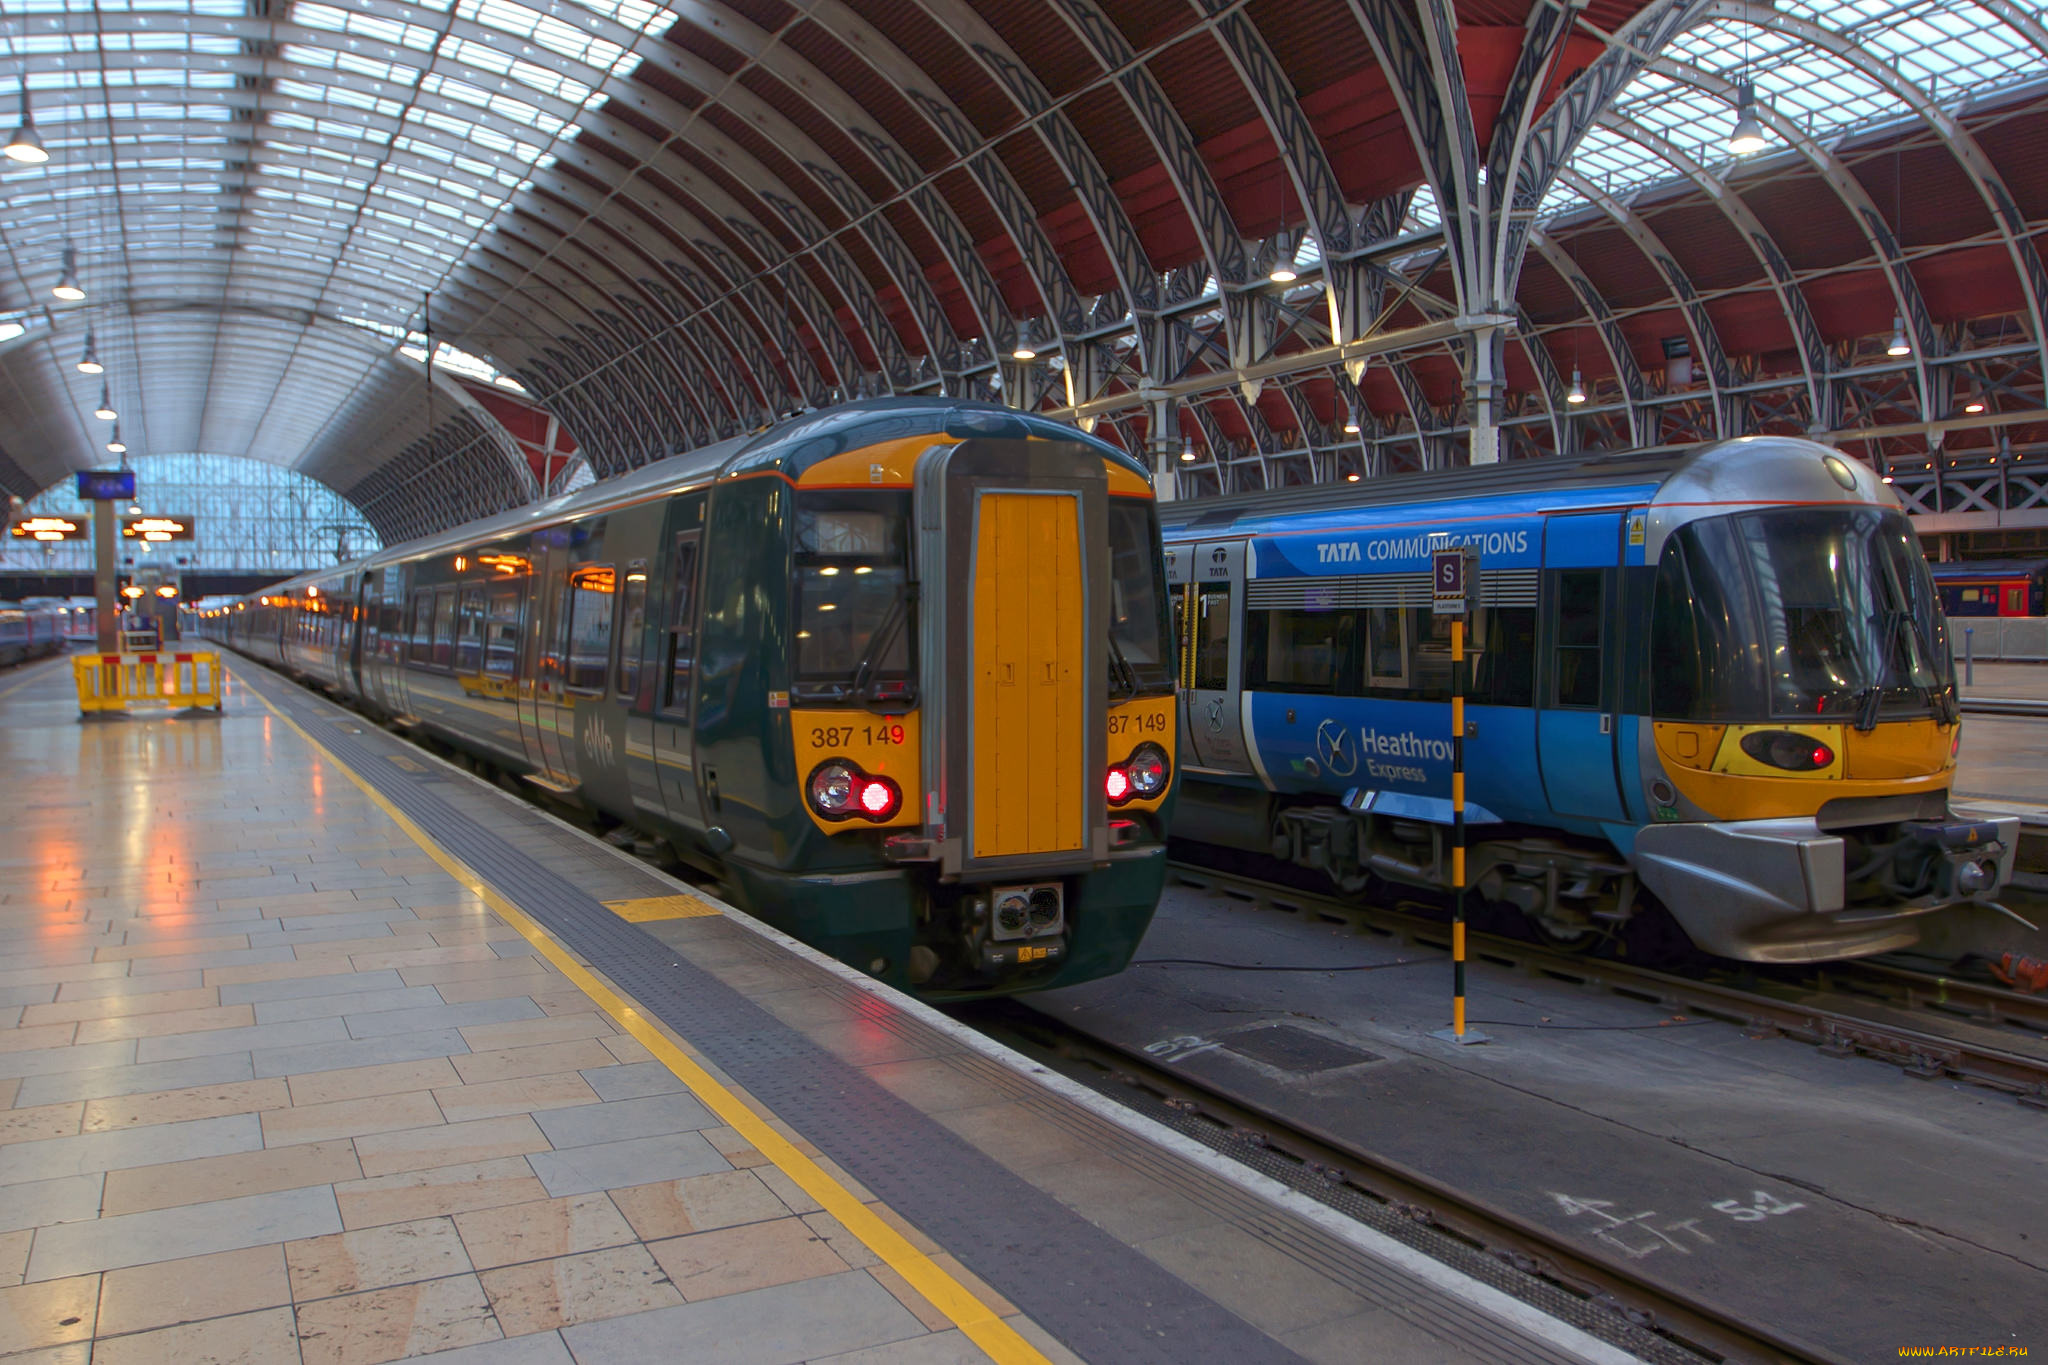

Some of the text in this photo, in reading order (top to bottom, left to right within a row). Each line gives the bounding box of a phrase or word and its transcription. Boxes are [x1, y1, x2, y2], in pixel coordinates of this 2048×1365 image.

[1317, 531, 1528, 562] TATA COMMUNICATIONS
[1210, 567, 1228, 577] TATA
[1443, 563, 1454, 584] S
[1108, 713, 1166, 734] 87 149
[811, 724, 905, 748] 387 149
[1367, 758, 1427, 782] Express
